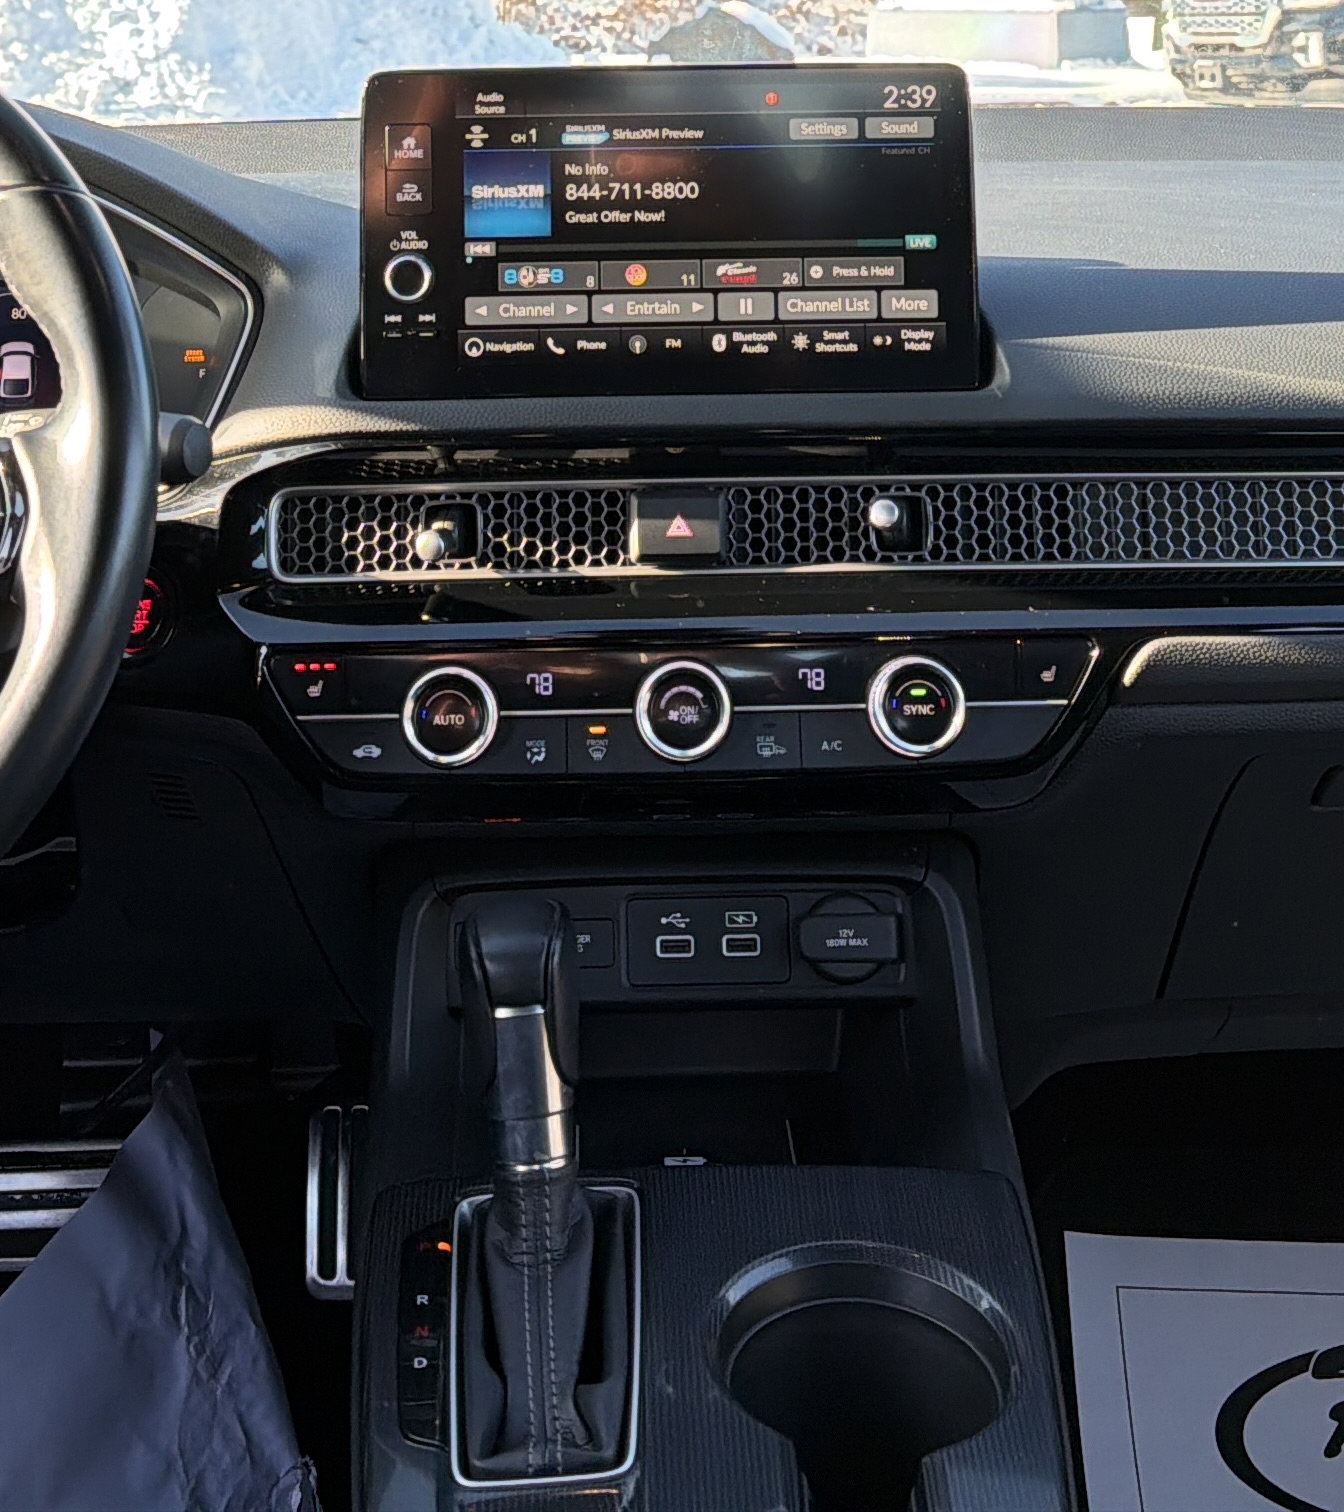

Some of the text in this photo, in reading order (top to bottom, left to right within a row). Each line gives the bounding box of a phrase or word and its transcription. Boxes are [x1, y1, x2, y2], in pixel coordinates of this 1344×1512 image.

[476, 92, 505, 103] Audio
[883, 85, 937, 109] 2:39
[474, 104, 506, 115] Source
[800, 122, 848, 136] Settings
[881, 121, 918, 134] Sound
[511, 128, 537, 144] CH 1
[613, 128, 704, 140] SiriusXM Preview
[394, 149, 424, 159] HOME
[881, 146, 930, 155] Featured CH
[564, 163, 609, 176] No Info
[396, 192, 423, 202] BACK
[471, 184, 545, 199] SiriusXM
[564, 182, 700, 201] 844-711-8800
[565, 209, 666, 224] Great Offer Now!
[400, 230, 419, 240] VOL
[400, 240, 428, 250] AUDIO
[909, 238, 931, 248] LIVE
[832, 266, 895, 277] Press & Hold
[586, 275, 595, 288] 8
[680, 274, 696, 287] 11
[782, 272, 799, 285] 26
[626, 299, 681, 315] Entrtain
[786, 298, 870, 313] Channel List
[891, 297, 929, 311] More
[11, 307, 27, 320] 80
[499, 303, 555, 318] Channel
[733, 331, 778, 342] Bluetooth
[822, 330, 850, 341] Smart
[901, 329, 935, 342] Display
[486, 340, 535, 354] Navigation
[577, 340, 607, 351] Phone
[665, 339, 682, 350] FM
[741, 343, 769, 354] Audio
[815, 342, 859, 353] Shortcuts
[905, 340, 931, 351] Mode
[199, 368, 207, 379] F
[526, 672, 553, 696] 78
[798, 668, 825, 691] 78
[679, 705, 699, 715] ON/
[902, 704, 936, 716] SYNC
[432, 713, 465, 726] AUTO
[680, 714, 700, 724] OFF
[820, 740, 843, 752] A/C
[838, 928, 855, 938] 12V
[848, 938, 869, 947] MAX
[416, 1294, 429, 1306] R
[415, 1325, 430, 1337] N
[413, 1357, 428, 1369] D
